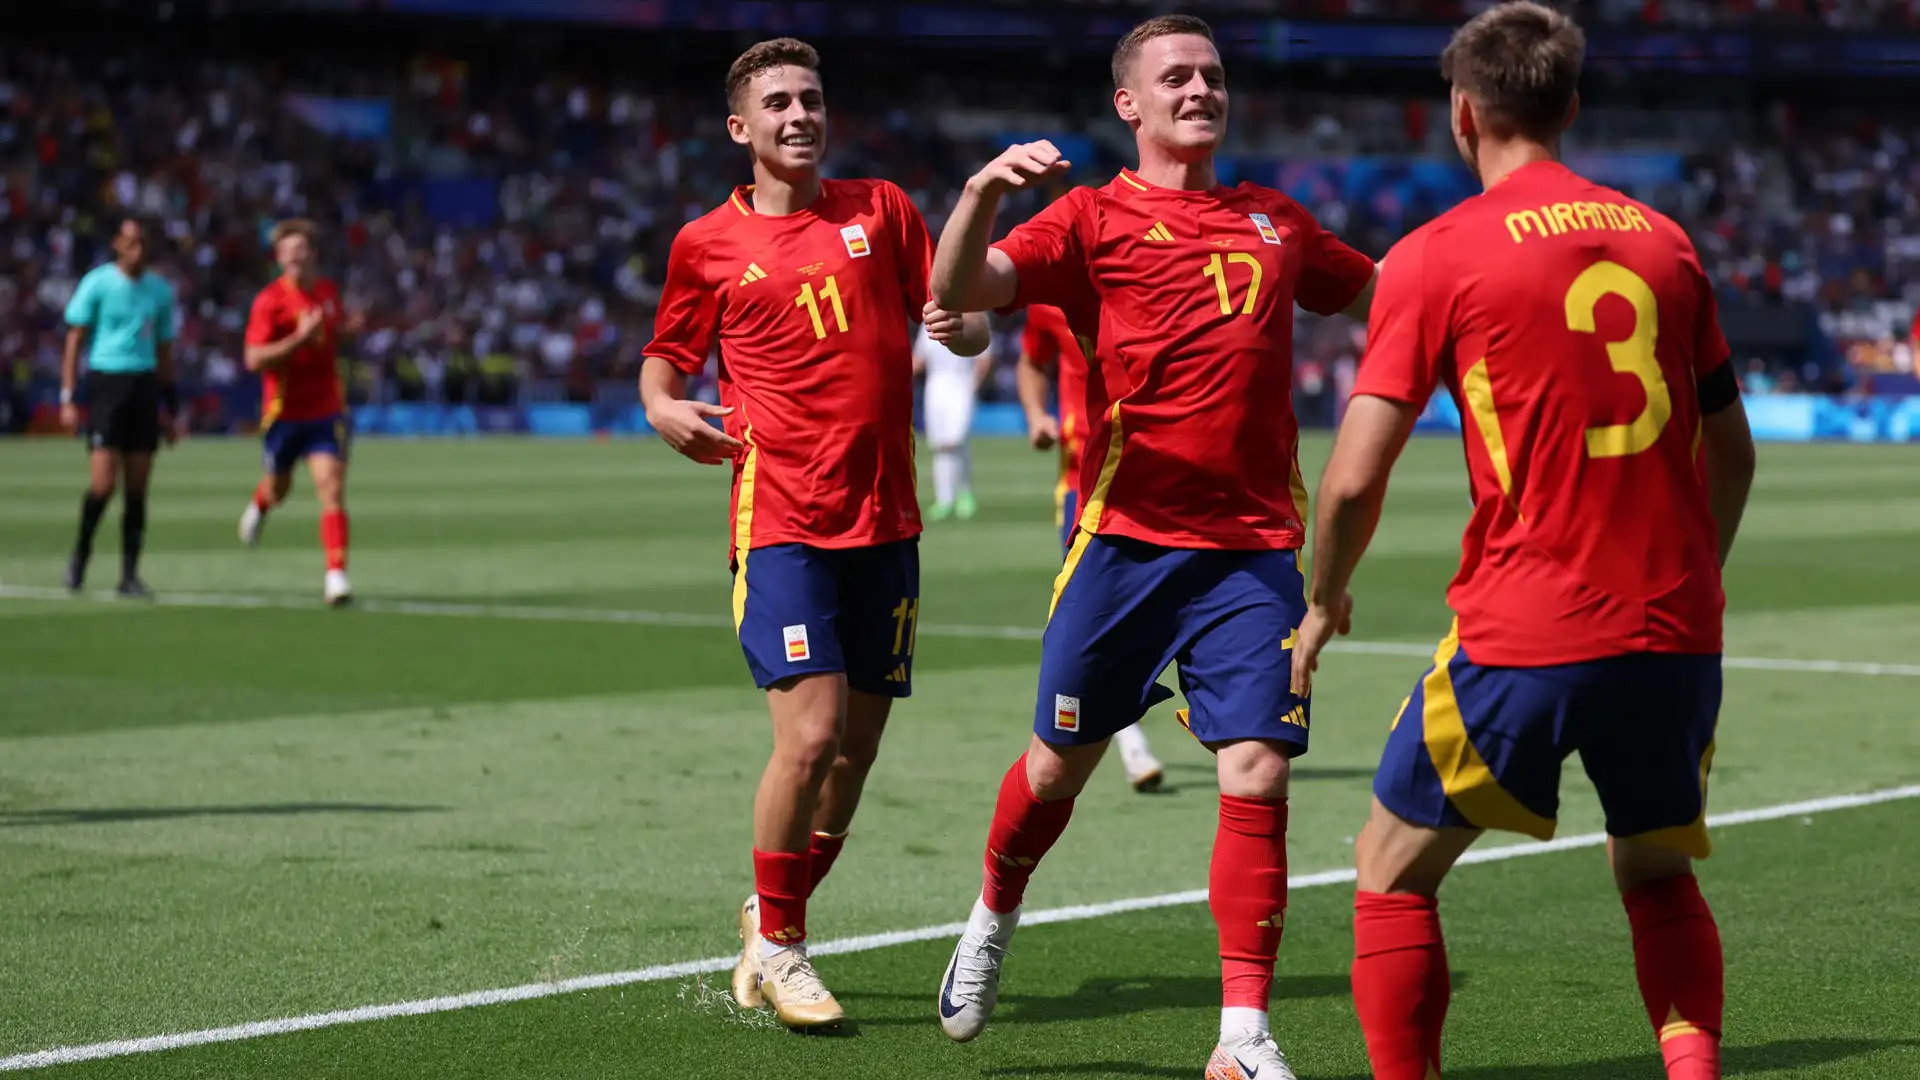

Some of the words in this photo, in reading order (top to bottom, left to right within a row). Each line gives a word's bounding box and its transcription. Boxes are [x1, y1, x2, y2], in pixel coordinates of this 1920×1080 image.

[1505, 201, 1652, 243] MIRANDA
[795, 275, 849, 339] 11
[1203, 252, 1262, 315] 17
[1564, 260, 1671, 459] 3
[892, 597, 918, 656] 11
